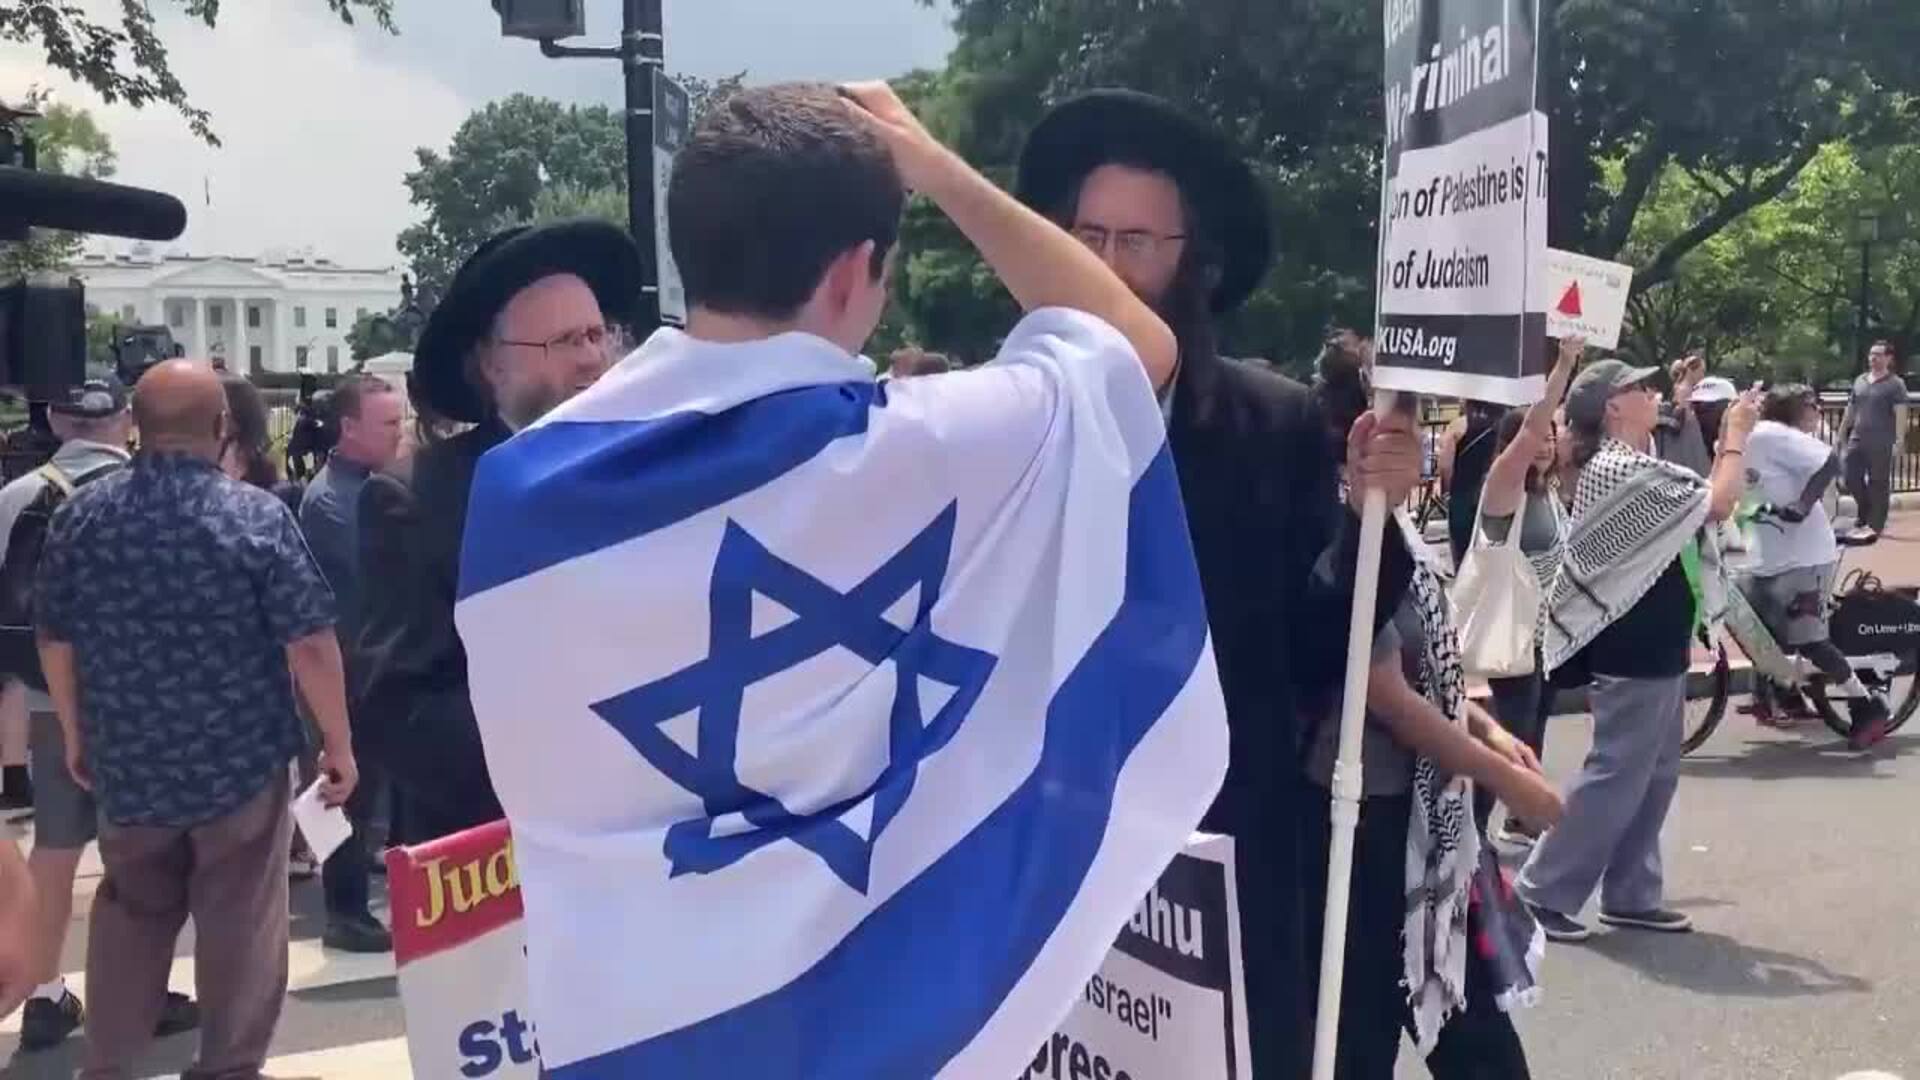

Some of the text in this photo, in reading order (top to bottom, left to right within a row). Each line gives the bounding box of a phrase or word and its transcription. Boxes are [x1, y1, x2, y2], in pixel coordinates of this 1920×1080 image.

[1414, 178, 1440, 218] of
[1440, 164, 1508, 216] Palestine
[1511, 157, 1524, 201] is
[1393, 250, 1416, 289] of
[1417, 246, 1489, 289] Judaism
[416, 838, 518, 928] Jud
[458, 1009, 540, 1078] st
